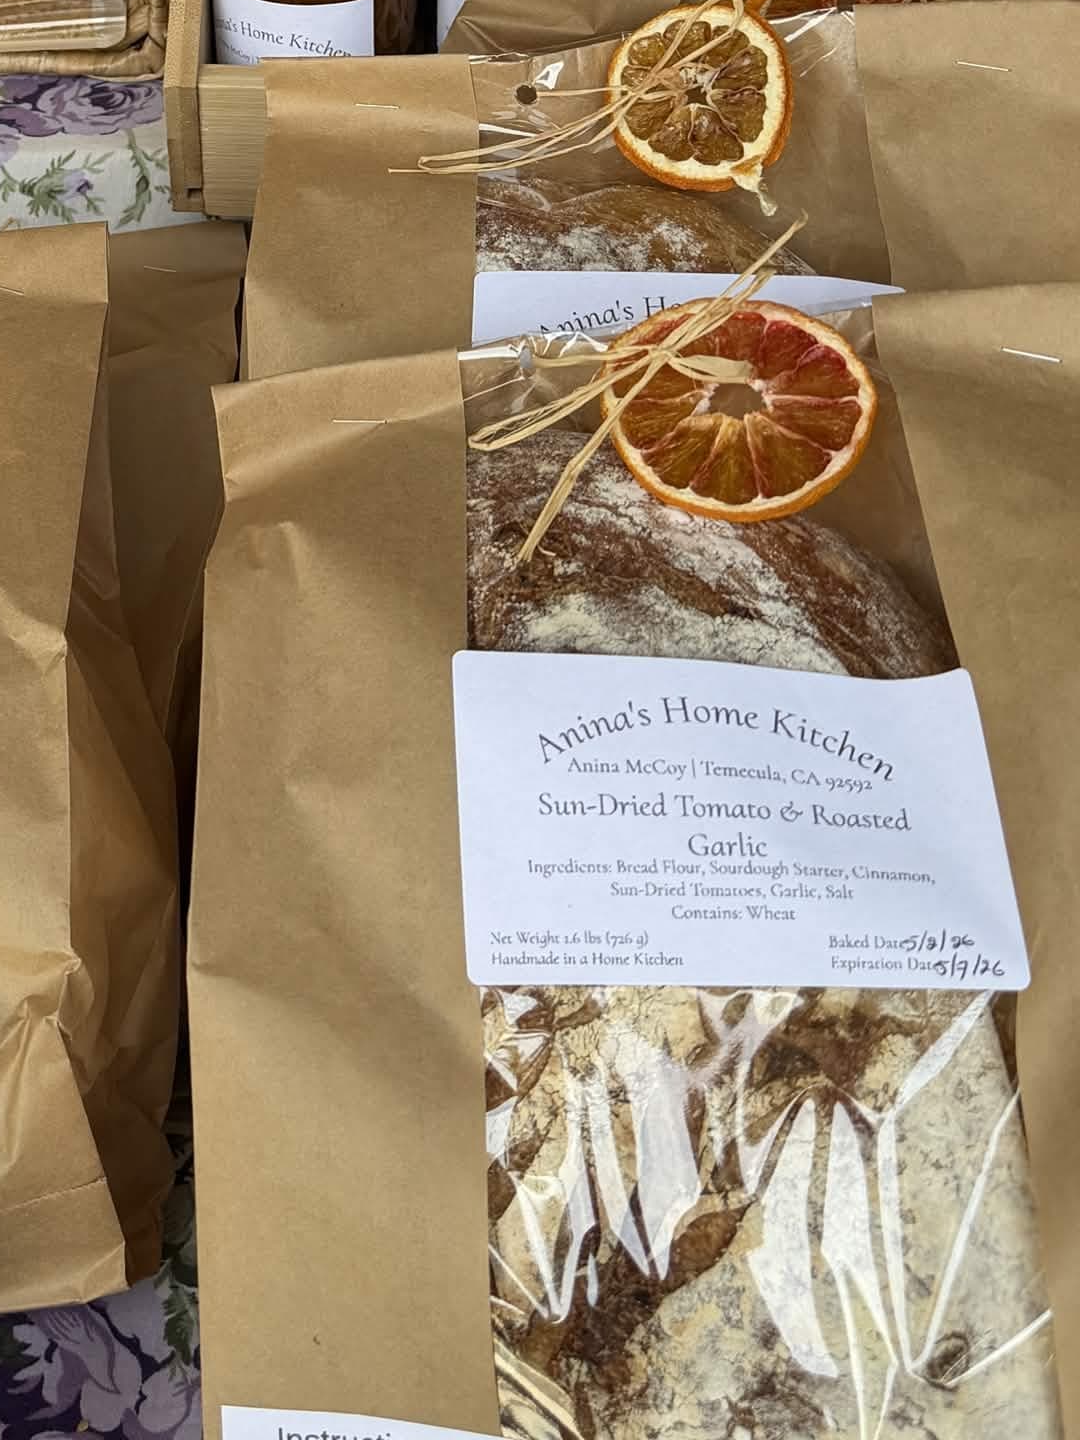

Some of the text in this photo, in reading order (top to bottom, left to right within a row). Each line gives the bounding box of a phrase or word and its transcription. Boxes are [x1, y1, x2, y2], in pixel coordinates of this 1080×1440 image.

[240, 21, 283, 44] Home
[538, 696, 895, 781] Anina's Home Kitchen
[568, 758, 872, 793] Anina McCoy Temecula, CA 92592
[538, 792, 911, 831] Sun-Dried Tomato & Roasted
[688, 832, 768, 857] Garlic
[528, 858, 936, 884] Ingredients: Bread Flour, Sourdough Starter, Cinnamon,
[610, 881, 854, 900] Sun-Dried Tomatoes, Garlic, Salt
[671, 904, 796, 920] Contains: Wheat
[491, 932, 512, 944] Net
[516, 930, 560, 948] Weight
[584, 931, 602, 944] lbs
[606, 931, 632, 948] (726
[636, 931, 648, 948] g)
[829, 934, 869, 948] Baked
[491, 951, 683, 965] Handmade in Home Kitchen
[832, 956, 902, 973] Expiration
